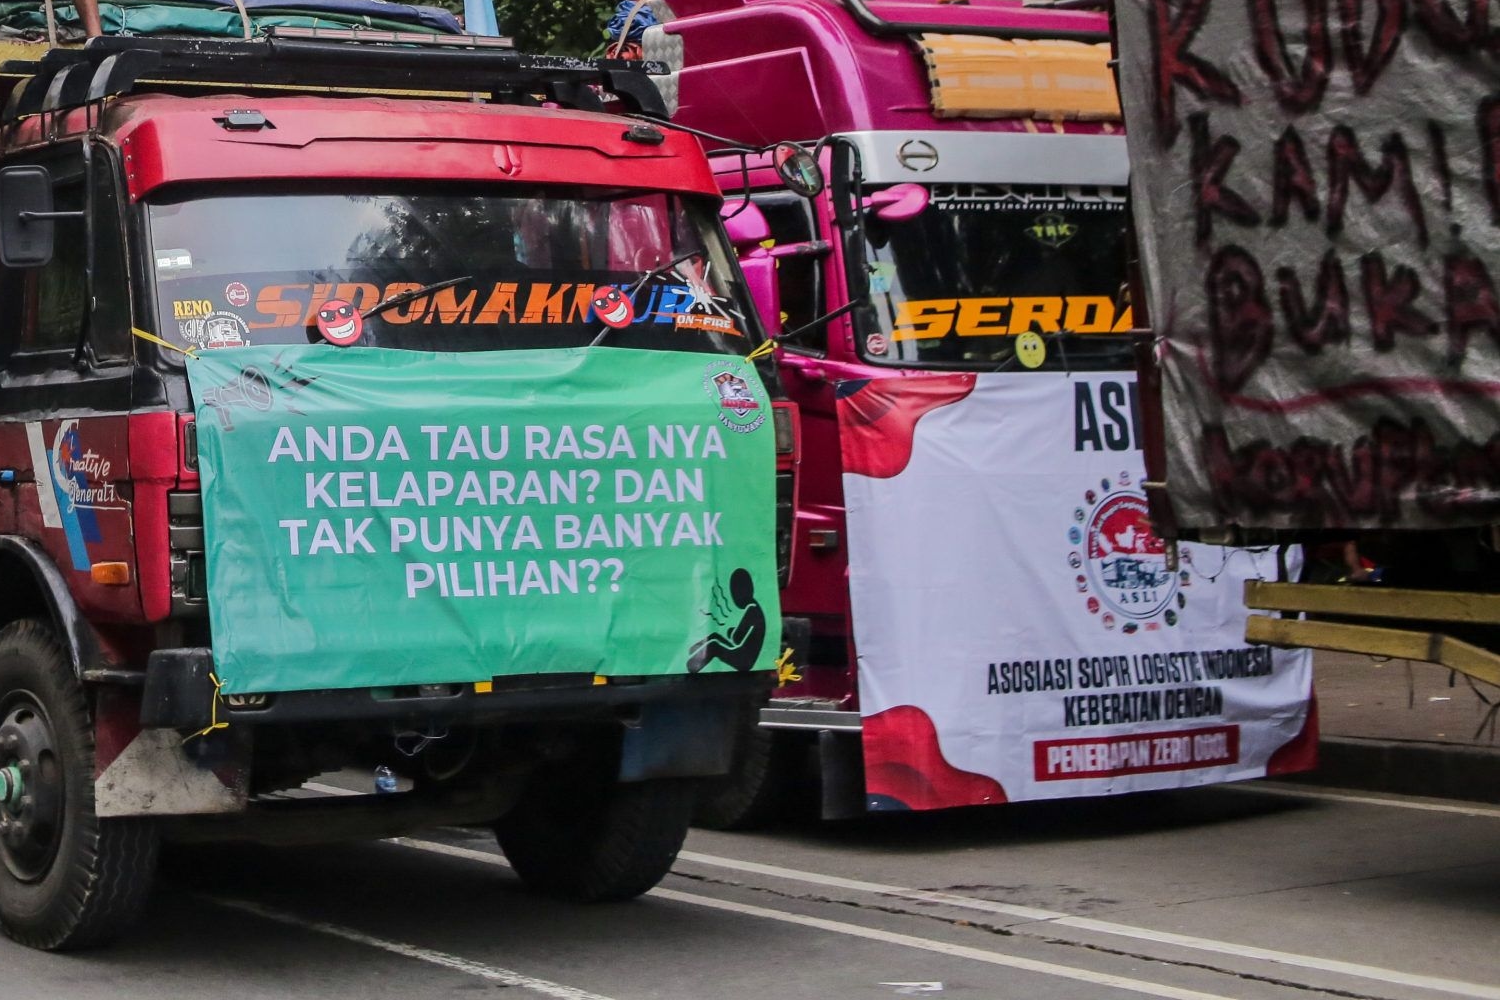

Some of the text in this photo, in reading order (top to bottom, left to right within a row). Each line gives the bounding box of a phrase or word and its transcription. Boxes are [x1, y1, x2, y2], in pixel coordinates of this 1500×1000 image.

[938, 202, 990, 212] Working
[994, 202, 1052, 212] Sincerely
[1056, 202, 1080, 211] Will
[173, 300, 212, 317] RENO
[676, 315, 732, 329] ON-FIRE
[267, 424, 727, 462] ANDA TAU RASA NYA
[305, 468, 703, 508] KELAPARAN? DAN
[279, 511, 724, 556] TAK PUNYA BANYAK
[405, 558, 625, 598] PILIHAN??
[1119, 591, 1158, 604] ASLI
[988, 657, 1074, 696] ASOSIASI
[1078, 654, 1130, 690] SOPIR
[1064, 686, 1223, 728] KEBERATAN DENGAN
[1047, 740, 1149, 775] PENERAPAN
[1153, 736, 1190, 765] ZERO
